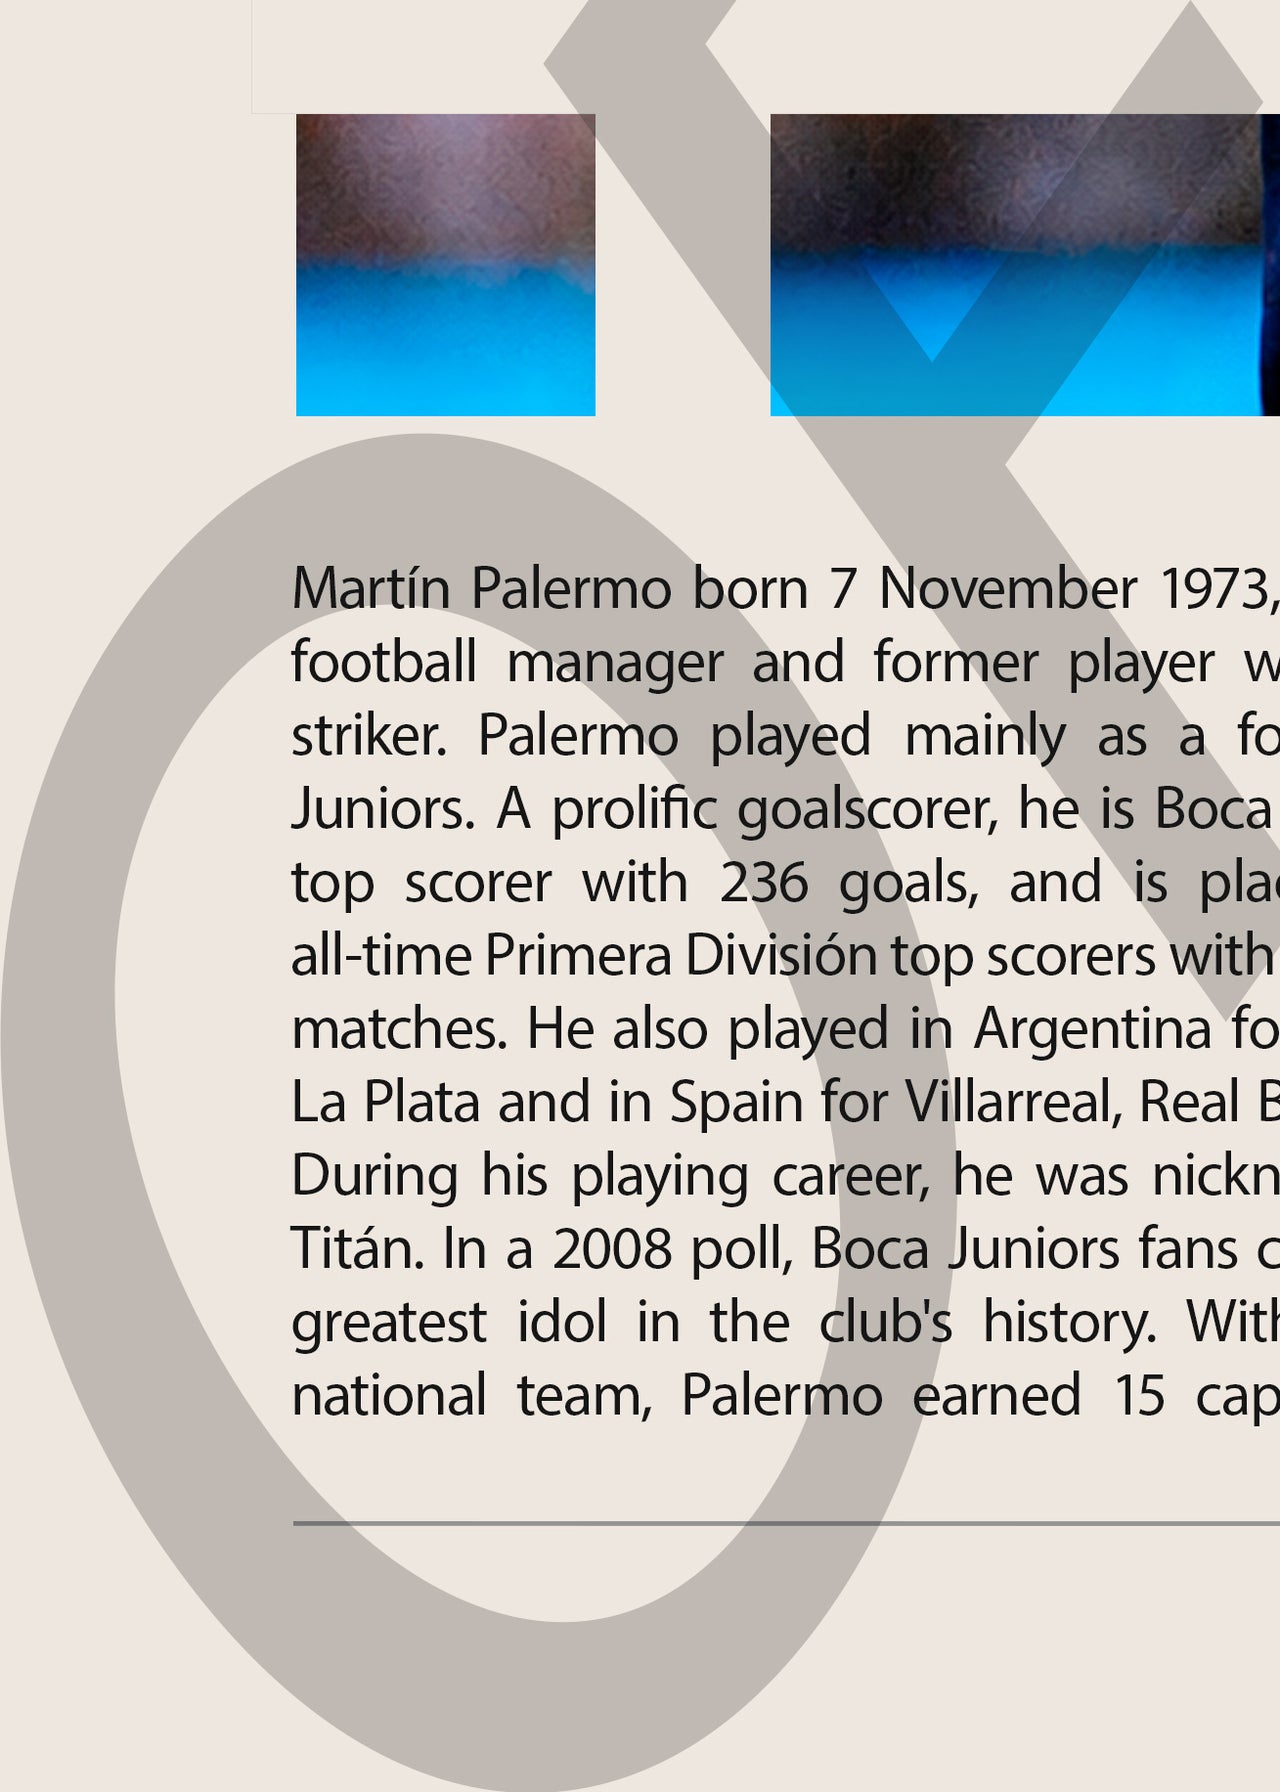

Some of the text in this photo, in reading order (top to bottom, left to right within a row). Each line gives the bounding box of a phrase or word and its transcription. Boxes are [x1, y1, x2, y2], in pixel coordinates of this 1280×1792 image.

[292, 564, 450, 611] Martín
[473, 562, 673, 611] Palermo
[693, 562, 808, 611] born
[829, 566, 859, 610] 7
[881, 562, 1140, 611] November
[291, 709, 447, 758] striker.
[480, 709, 680, 758] Palermo
[711, 708, 871, 769] played
[906, 708, 1069, 769] mainly
[1097, 722, 1148, 758] as
[1178, 722, 1206, 758] a
[289, 784, 476, 831] Juniors.
[495, 784, 533, 830] A
[553, 782, 719, 842] prolific
[737, 782, 999, 843] goalscorer,
[1020, 782, 1081, 831] he
[1101, 784, 1136, 831] is
[1156, 784, 1272, 831] Boca
[290, 929, 473, 978] all-time
[487, 930, 672, 978] Primera
[687, 930, 878, 978] División
[888, 934, 975, 988] top
[986, 942, 1157, 978] scorers
[1168, 928, 1275, 978] with
[293, 1002, 508, 1051] matches.
[529, 1004, 596, 1051] He
[612, 1002, 709, 1051] also
[729, 1002, 889, 1062] played
[910, 1004, 953, 1050] in
[972, 1004, 1212, 1063] Argentina
[293, 1150, 458, 1209] During
[483, 1149, 549, 1198] his
[572, 1149, 749, 1209] playing
[772, 1162, 931, 1204] career,
[954, 1149, 1014, 1198] he
[1034, 1162, 1130, 1198] was
[291, 1301, 489, 1356] greatest
[518, 1295, 606, 1344] idol
[638, 1297, 680, 1343] in
[708, 1295, 791, 1344] the
[819, 1295, 954, 1344] club's
[984, 1295, 1157, 1356] history.
[293, 1369, 486, 1418] national
[515, 1374, 653, 1424] team,
[683, 1369, 884, 1418] Palermo
[912, 1369, 1081, 1418] earned
[1116, 1372, 1166, 1418] 15
